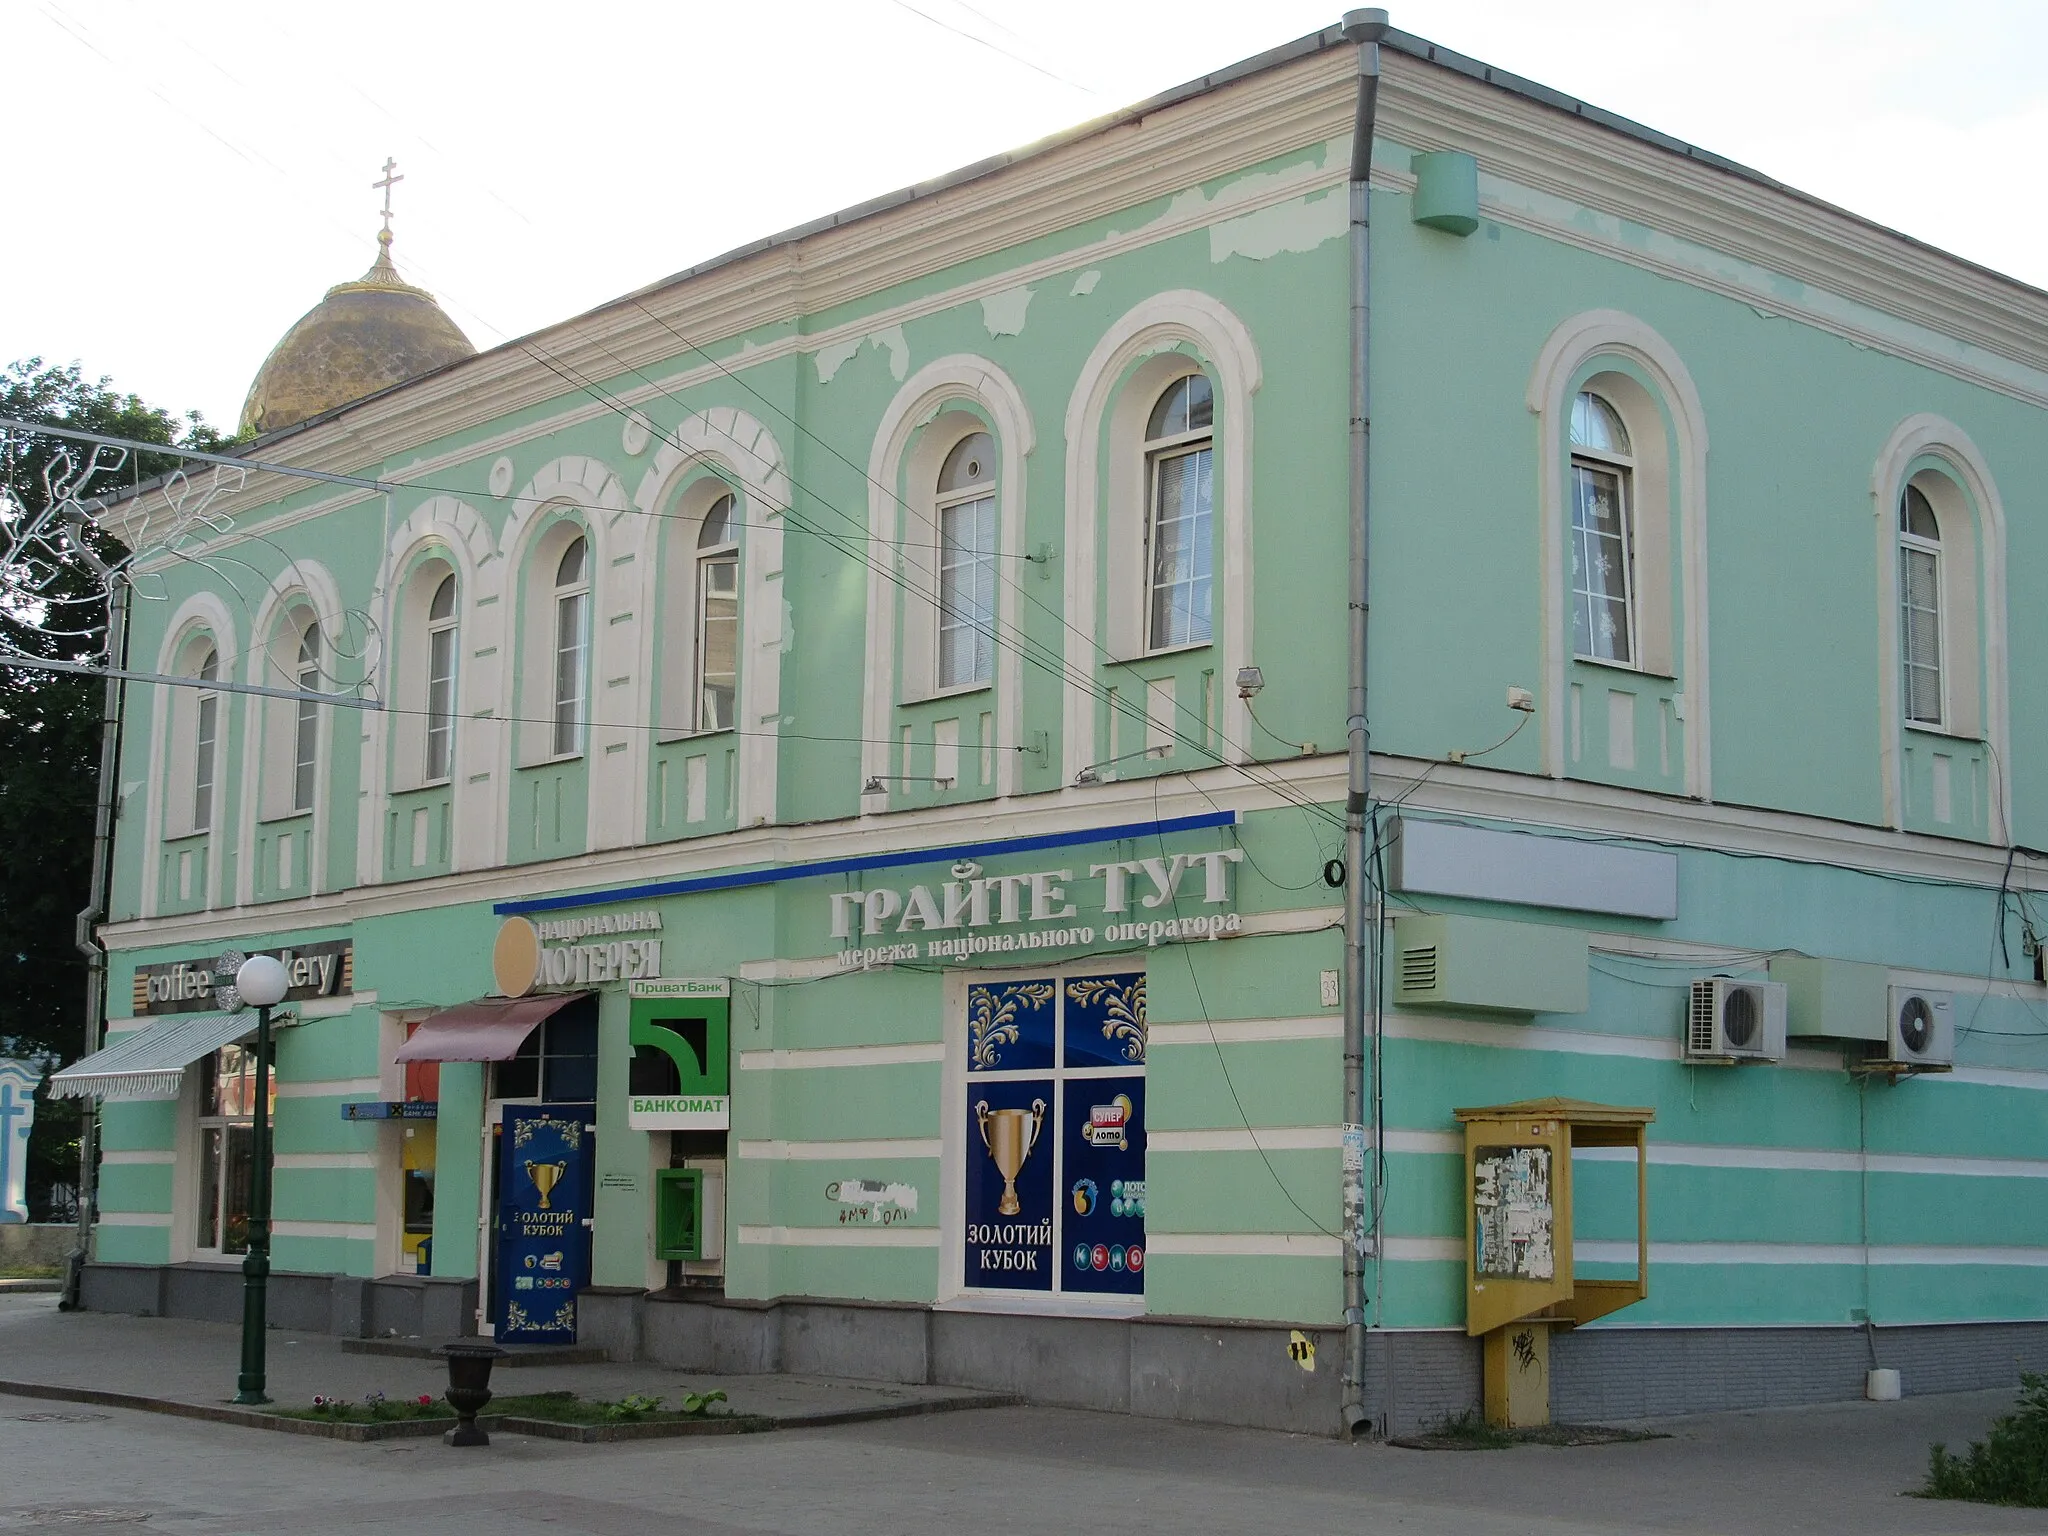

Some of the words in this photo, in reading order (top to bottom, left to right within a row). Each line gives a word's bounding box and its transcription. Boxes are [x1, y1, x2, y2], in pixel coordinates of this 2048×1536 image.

[829, 862, 1077, 937] ГРАЙТЕ
[1089, 848, 1244, 913] ТУТ
[538, 910, 663, 943] НАЦІОНАЛЬНА
[837, 942, 919, 971] мережа
[928, 925, 1095, 962] національного
[1104, 912, 1242, 946] оператора
[536, 938, 663, 986] ЛОТЕРЕЯ
[147, 962, 215, 1003] coffee
[634, 981, 723, 994] ПриватБанк
[633, 1099, 724, 1113] БАНКОМАТ
[1093, 1109, 1123, 1123] СУПЕР
[523, 1225, 564, 1236] КУБОК
[967, 1217, 1052, 1246] ЗОЛОТИЙ
[980, 1249, 1038, 1271] КУБОК
